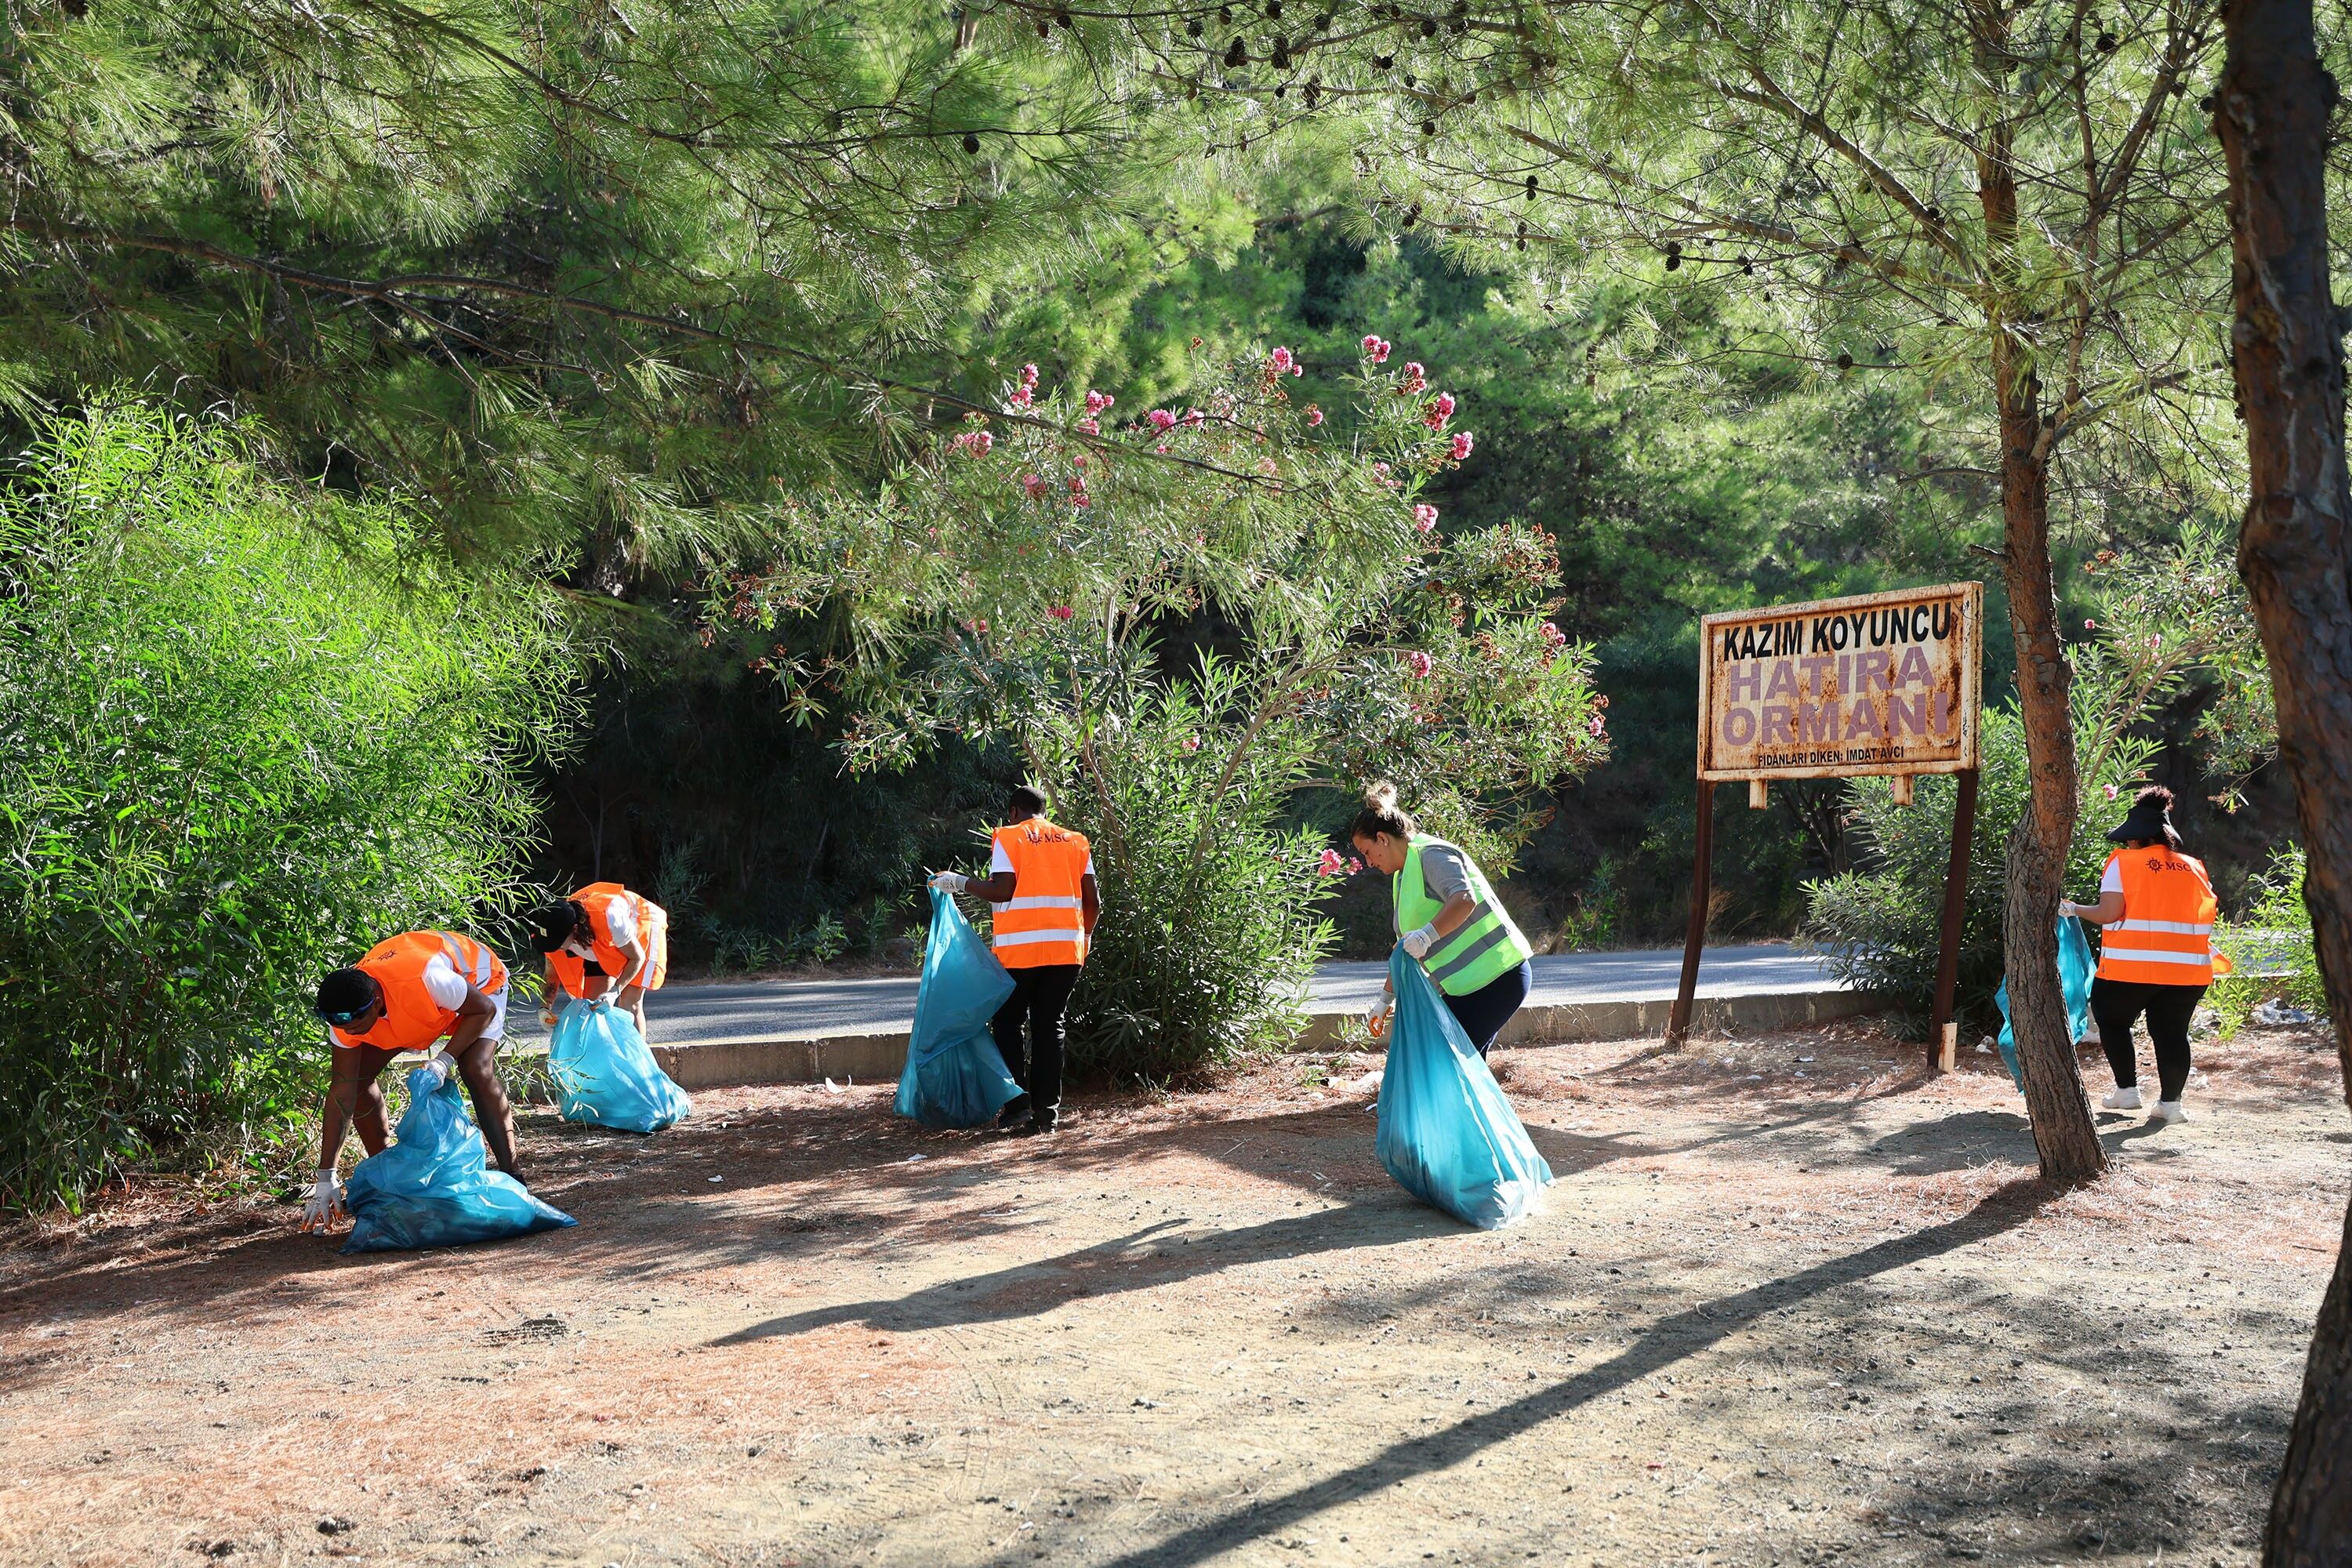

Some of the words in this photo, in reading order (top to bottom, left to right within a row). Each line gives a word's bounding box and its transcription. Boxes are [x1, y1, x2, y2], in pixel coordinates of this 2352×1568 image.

[1724, 619, 1803, 662] KAZIM
[1812, 601, 1951, 653] KOYUNCU
[1730, 646, 1936, 702] HATIRA
[1722, 691, 1948, 746] ORMANI
[1846, 747, 1877, 761] İMDAT
[1880, 746, 1904, 760] AVCI
